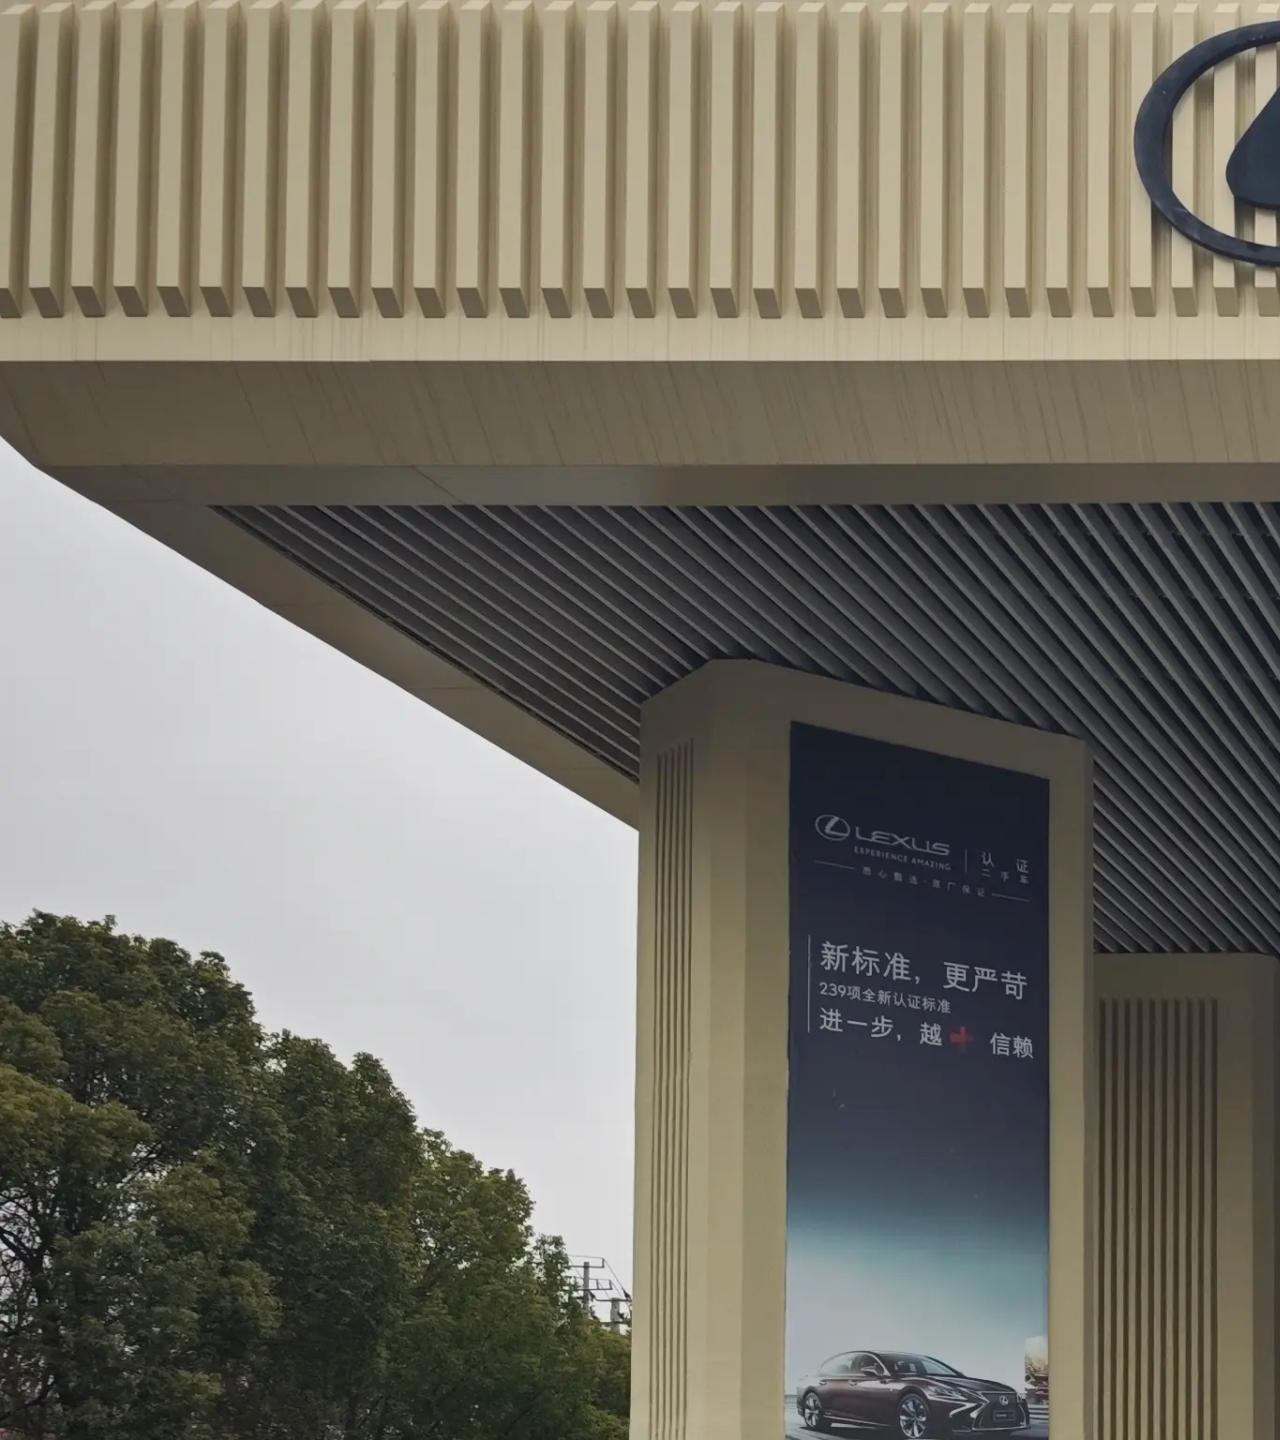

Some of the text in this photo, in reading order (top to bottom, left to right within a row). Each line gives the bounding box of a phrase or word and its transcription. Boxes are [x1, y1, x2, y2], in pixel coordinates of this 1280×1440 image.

[854, 845, 908, 864] EXPERIENCE
[855, 826, 950, 856] LEXUS
[819, 981, 951, 1015] 239项全新认证标准
[990, 1031, 1034, 1059] 信赖
